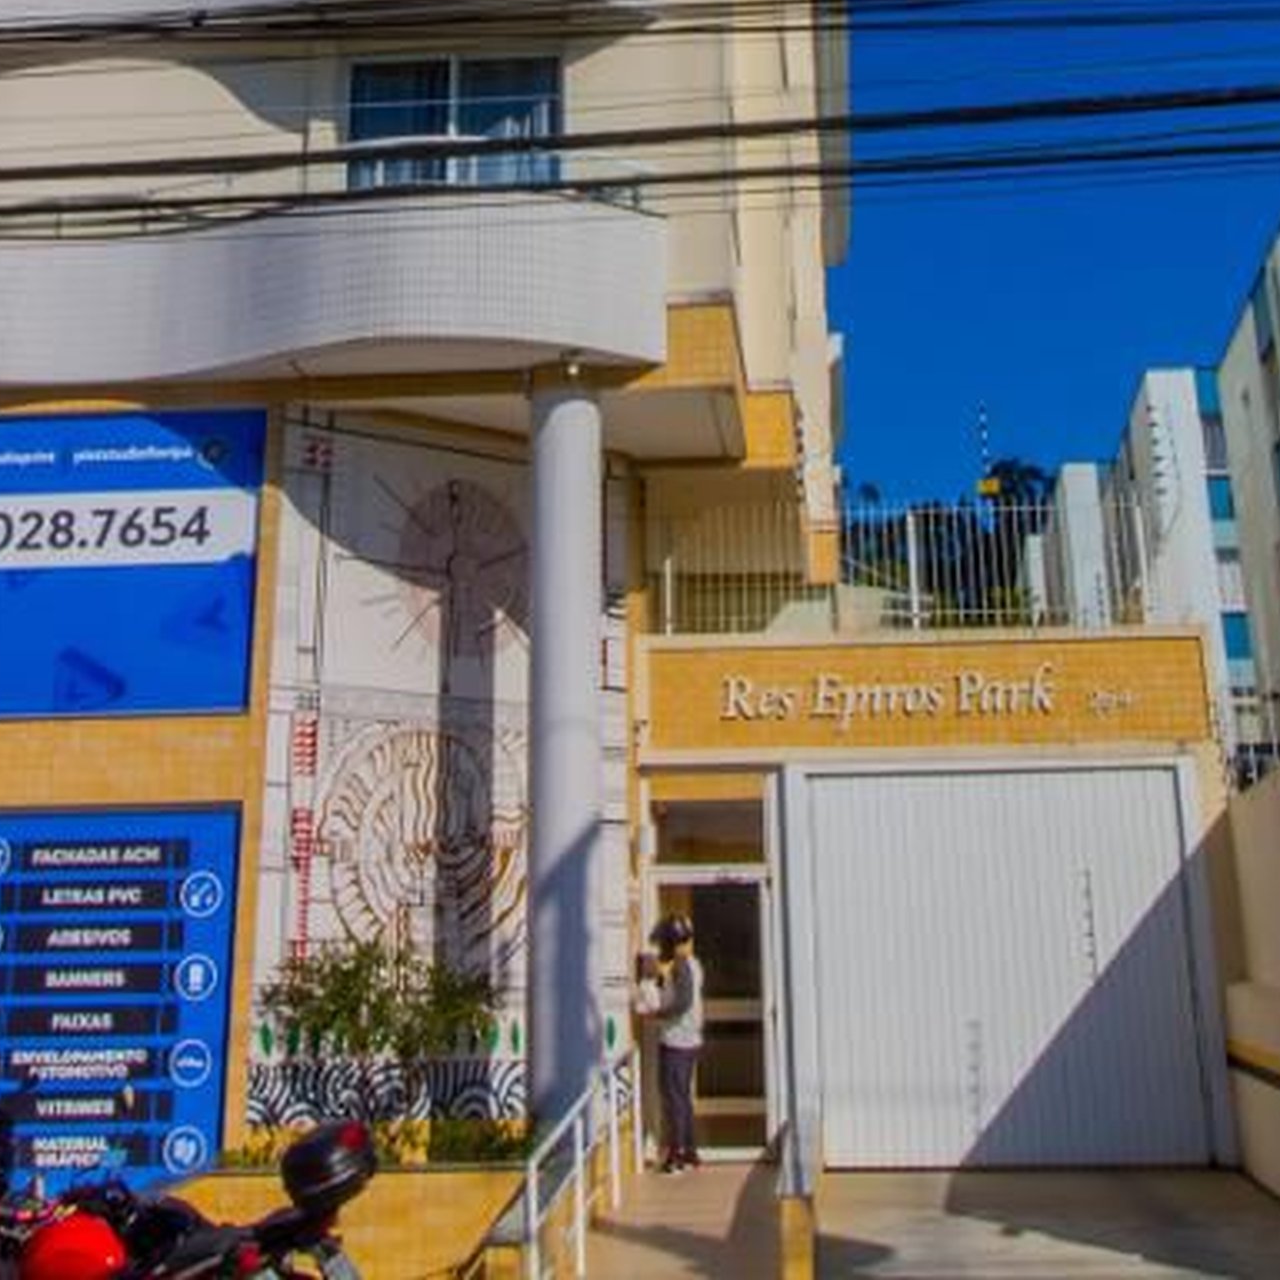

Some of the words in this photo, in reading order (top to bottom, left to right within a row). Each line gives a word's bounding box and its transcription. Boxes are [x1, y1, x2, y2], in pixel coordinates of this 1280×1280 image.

[720, 675, 796, 720] Res
[810, 674, 945, 732] Epiros
[956, 662, 1058, 717] Park
[32, 847, 118, 866] FACHADAS
[122, 845, 161, 863] ACM
[42, 888, 105, 904] LETRAS
[107, 886, 142, 904] PVC
[47, 927, 131, 947] ADESIVOS
[46, 969, 125, 988] BANNERS
[52, 1012, 113, 1031] FAIXAS
[11, 1048, 147, 1065] ENVELOPAMENTO
[35, 1098, 115, 1116] VITRINES
[32, 1135, 107, 1152] MATERIAL
